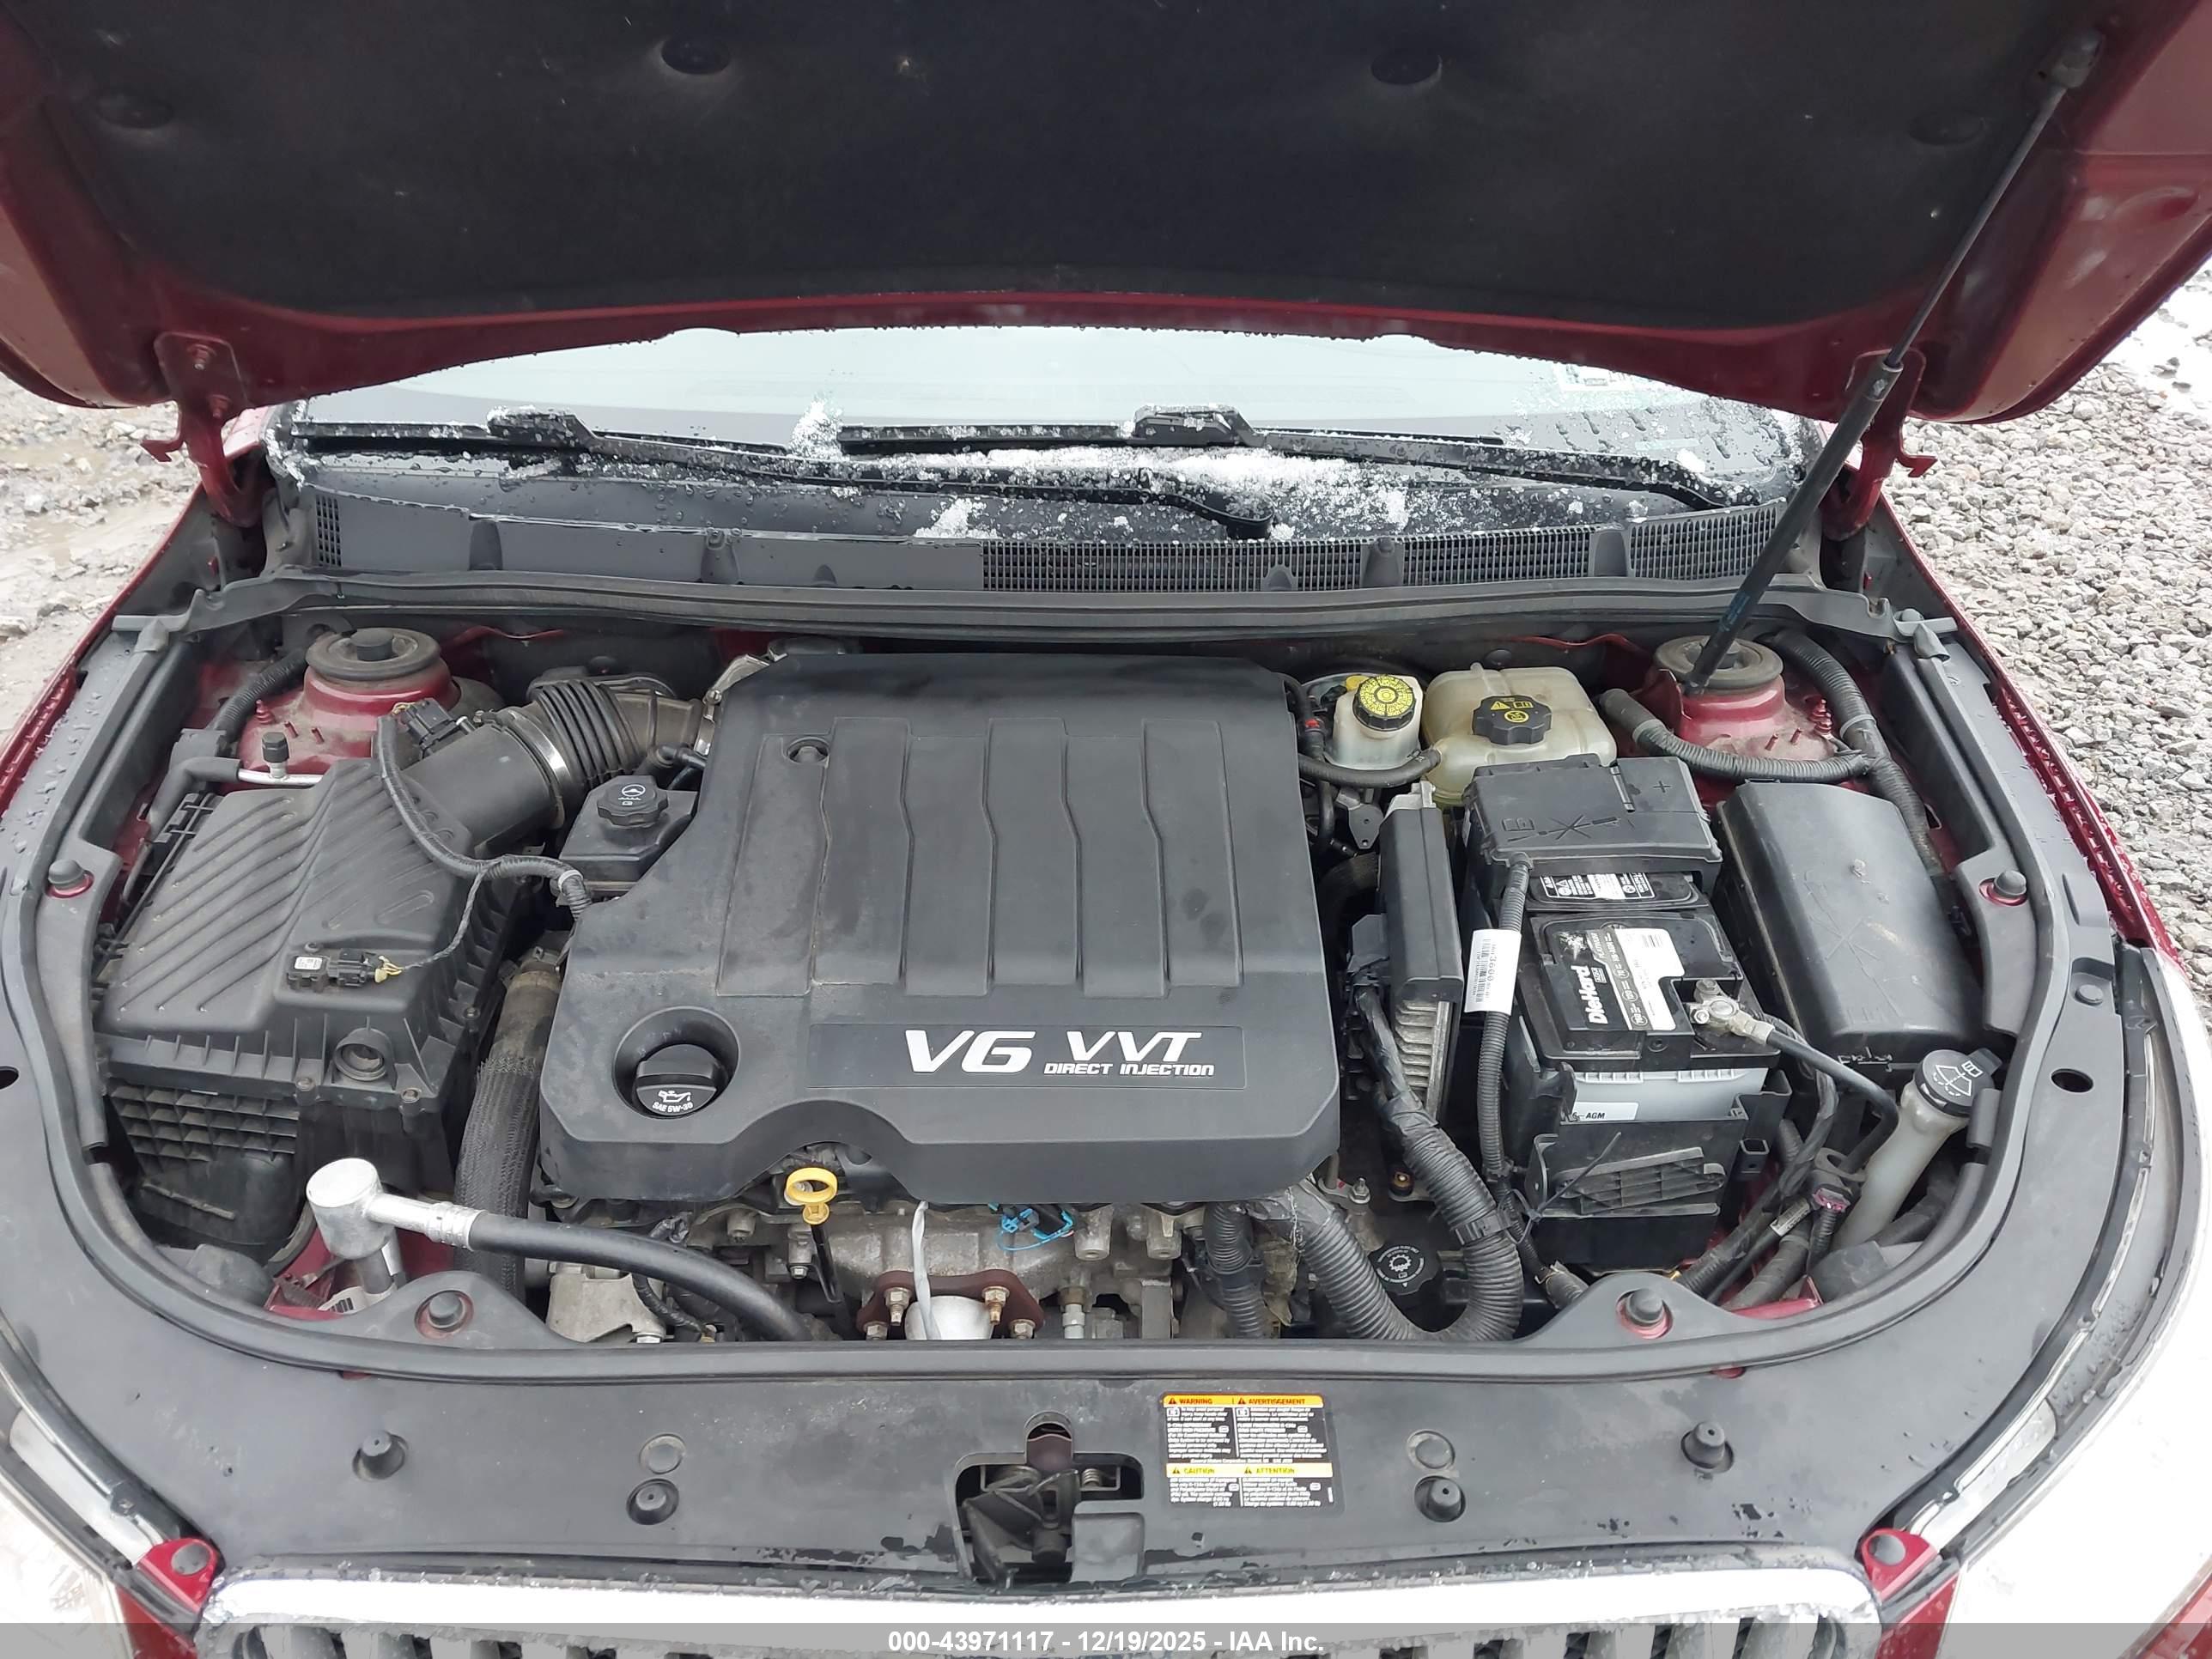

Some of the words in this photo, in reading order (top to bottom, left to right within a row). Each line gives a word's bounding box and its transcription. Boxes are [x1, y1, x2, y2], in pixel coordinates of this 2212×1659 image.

[1570, 965, 1608, 1024] DieHard
[905, 1030, 1036, 1073] V6
[1066, 1030, 1202, 1062] VVT
[1043, 1062, 1114, 1076] DIRECT
[1119, 1063, 1215, 1077] INJECTION
[652, 1102, 667, 1113] SAE
[667, 1102, 694, 1114] 5W-30
